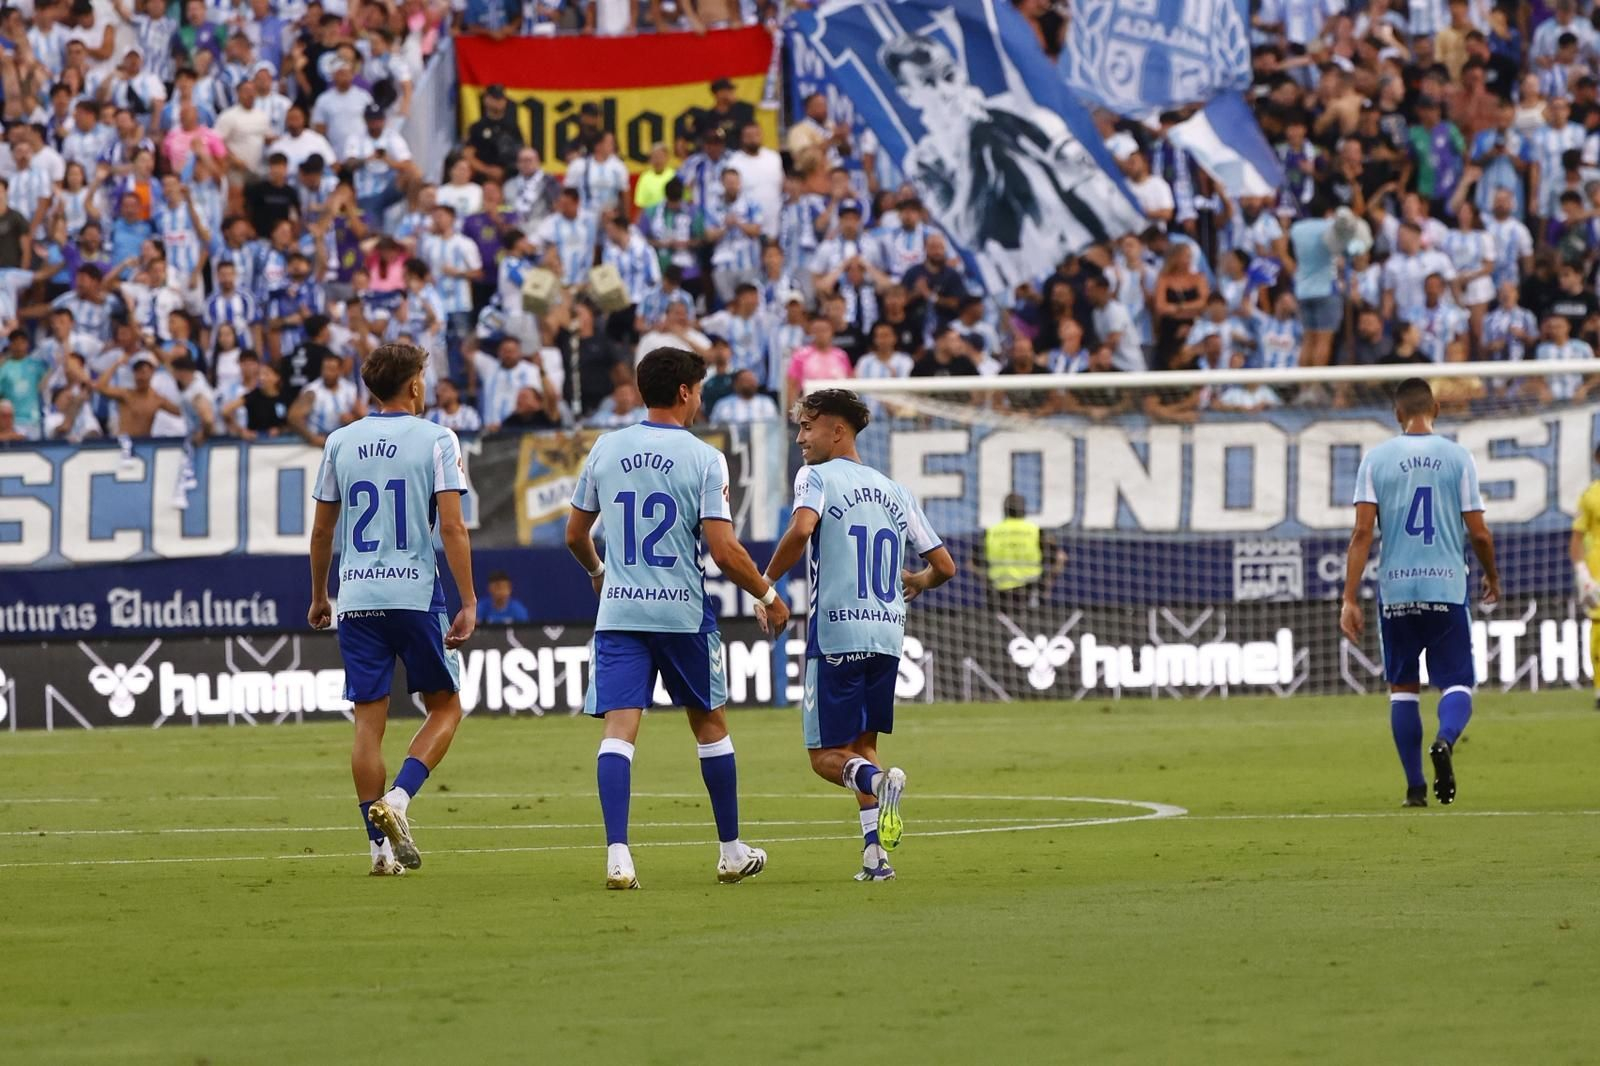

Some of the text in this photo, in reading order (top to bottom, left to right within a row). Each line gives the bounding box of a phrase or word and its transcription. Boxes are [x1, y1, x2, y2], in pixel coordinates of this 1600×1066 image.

[357, 438, 398, 460] NIÑO
[620, 452, 675, 475] DOTOR
[890, 418, 1390, 532] FONDO
[1400, 456, 1442, 473] EINAR
[349, 478, 408, 553] 21
[613, 490, 678, 569] 12
[1404, 485, 1436, 546] 4
[342, 566, 420, 583] BENAHAVIS
[847, 523, 900, 604] 10
[1388, 566, 1455, 580] BENAHAVIS
[606, 585, 691, 602] BENAHAVIS
[455, 646, 593, 713] VISIT
[1079, 628, 1294, 689] hummel
[158, 660, 350, 717] humme
